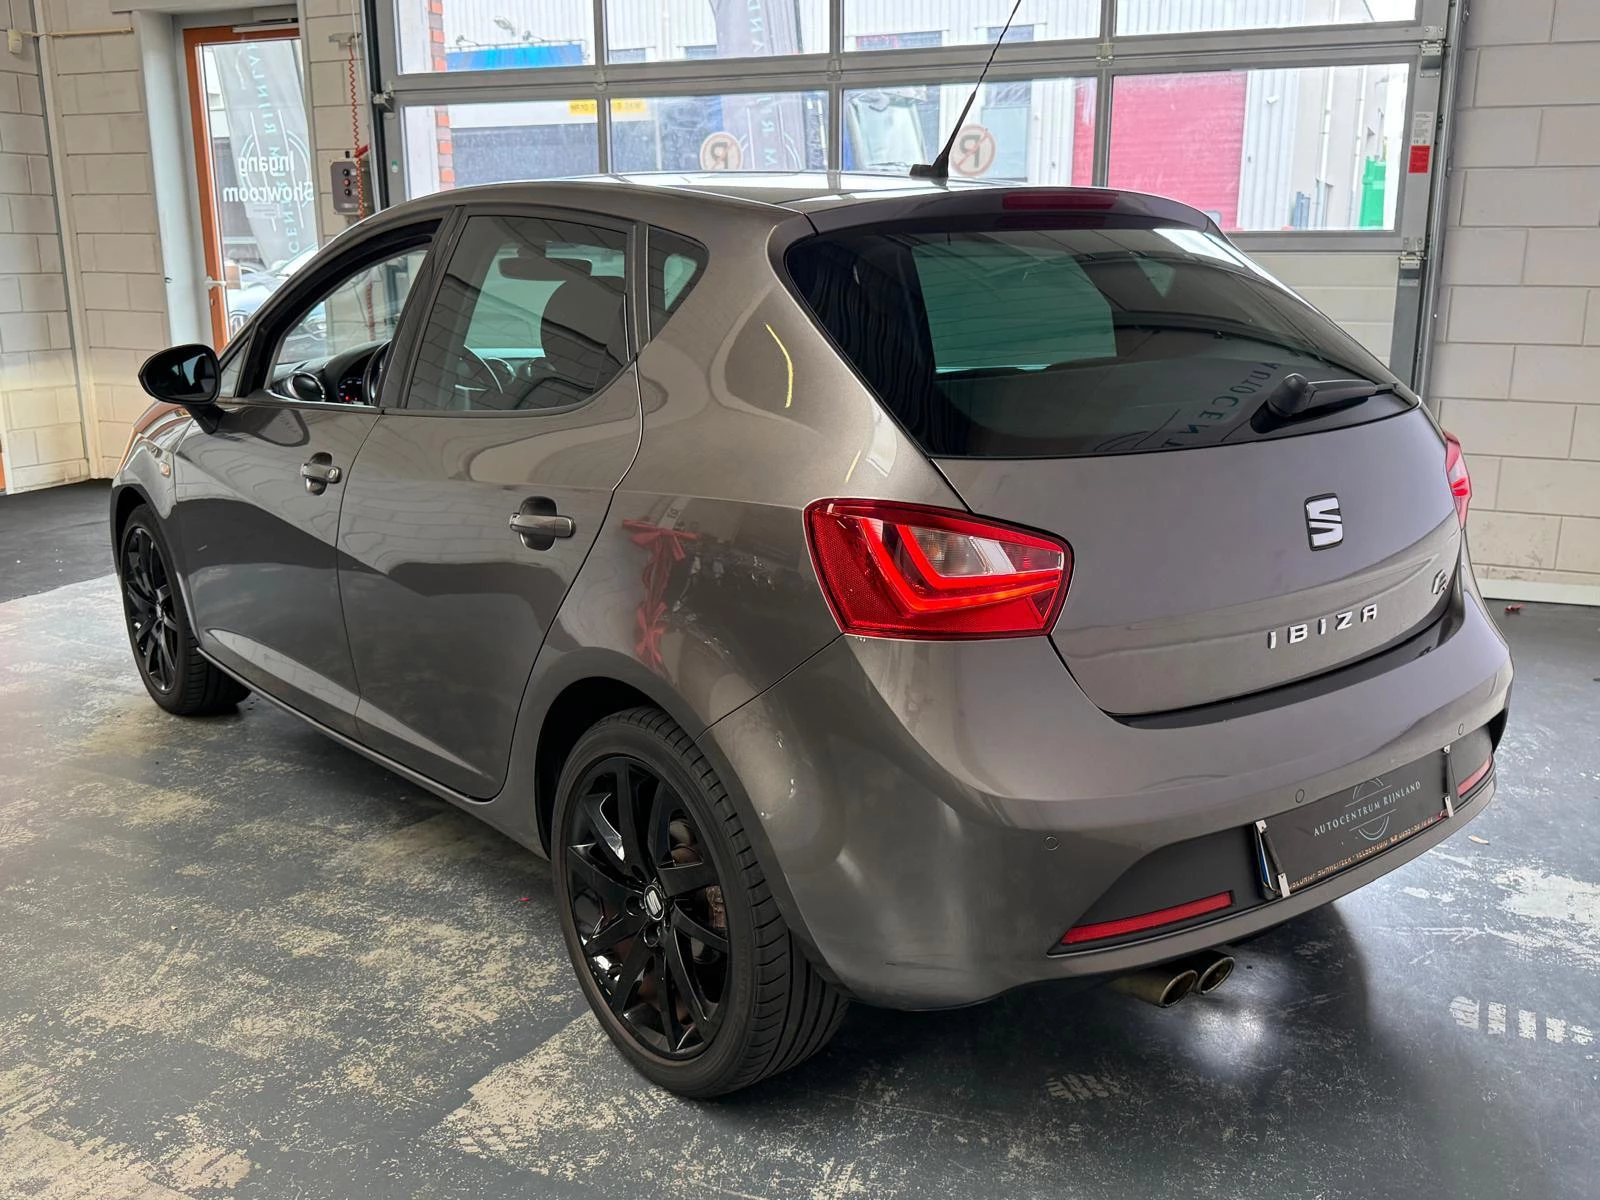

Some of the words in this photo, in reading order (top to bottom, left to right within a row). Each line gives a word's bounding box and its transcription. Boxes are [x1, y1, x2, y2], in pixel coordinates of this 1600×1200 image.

[1267, 603, 1378, 650] IBIZA
[1313, 801, 1381, 837] AUTOCENTRUM
[1382, 780, 1422, 806] RIJNLAND
